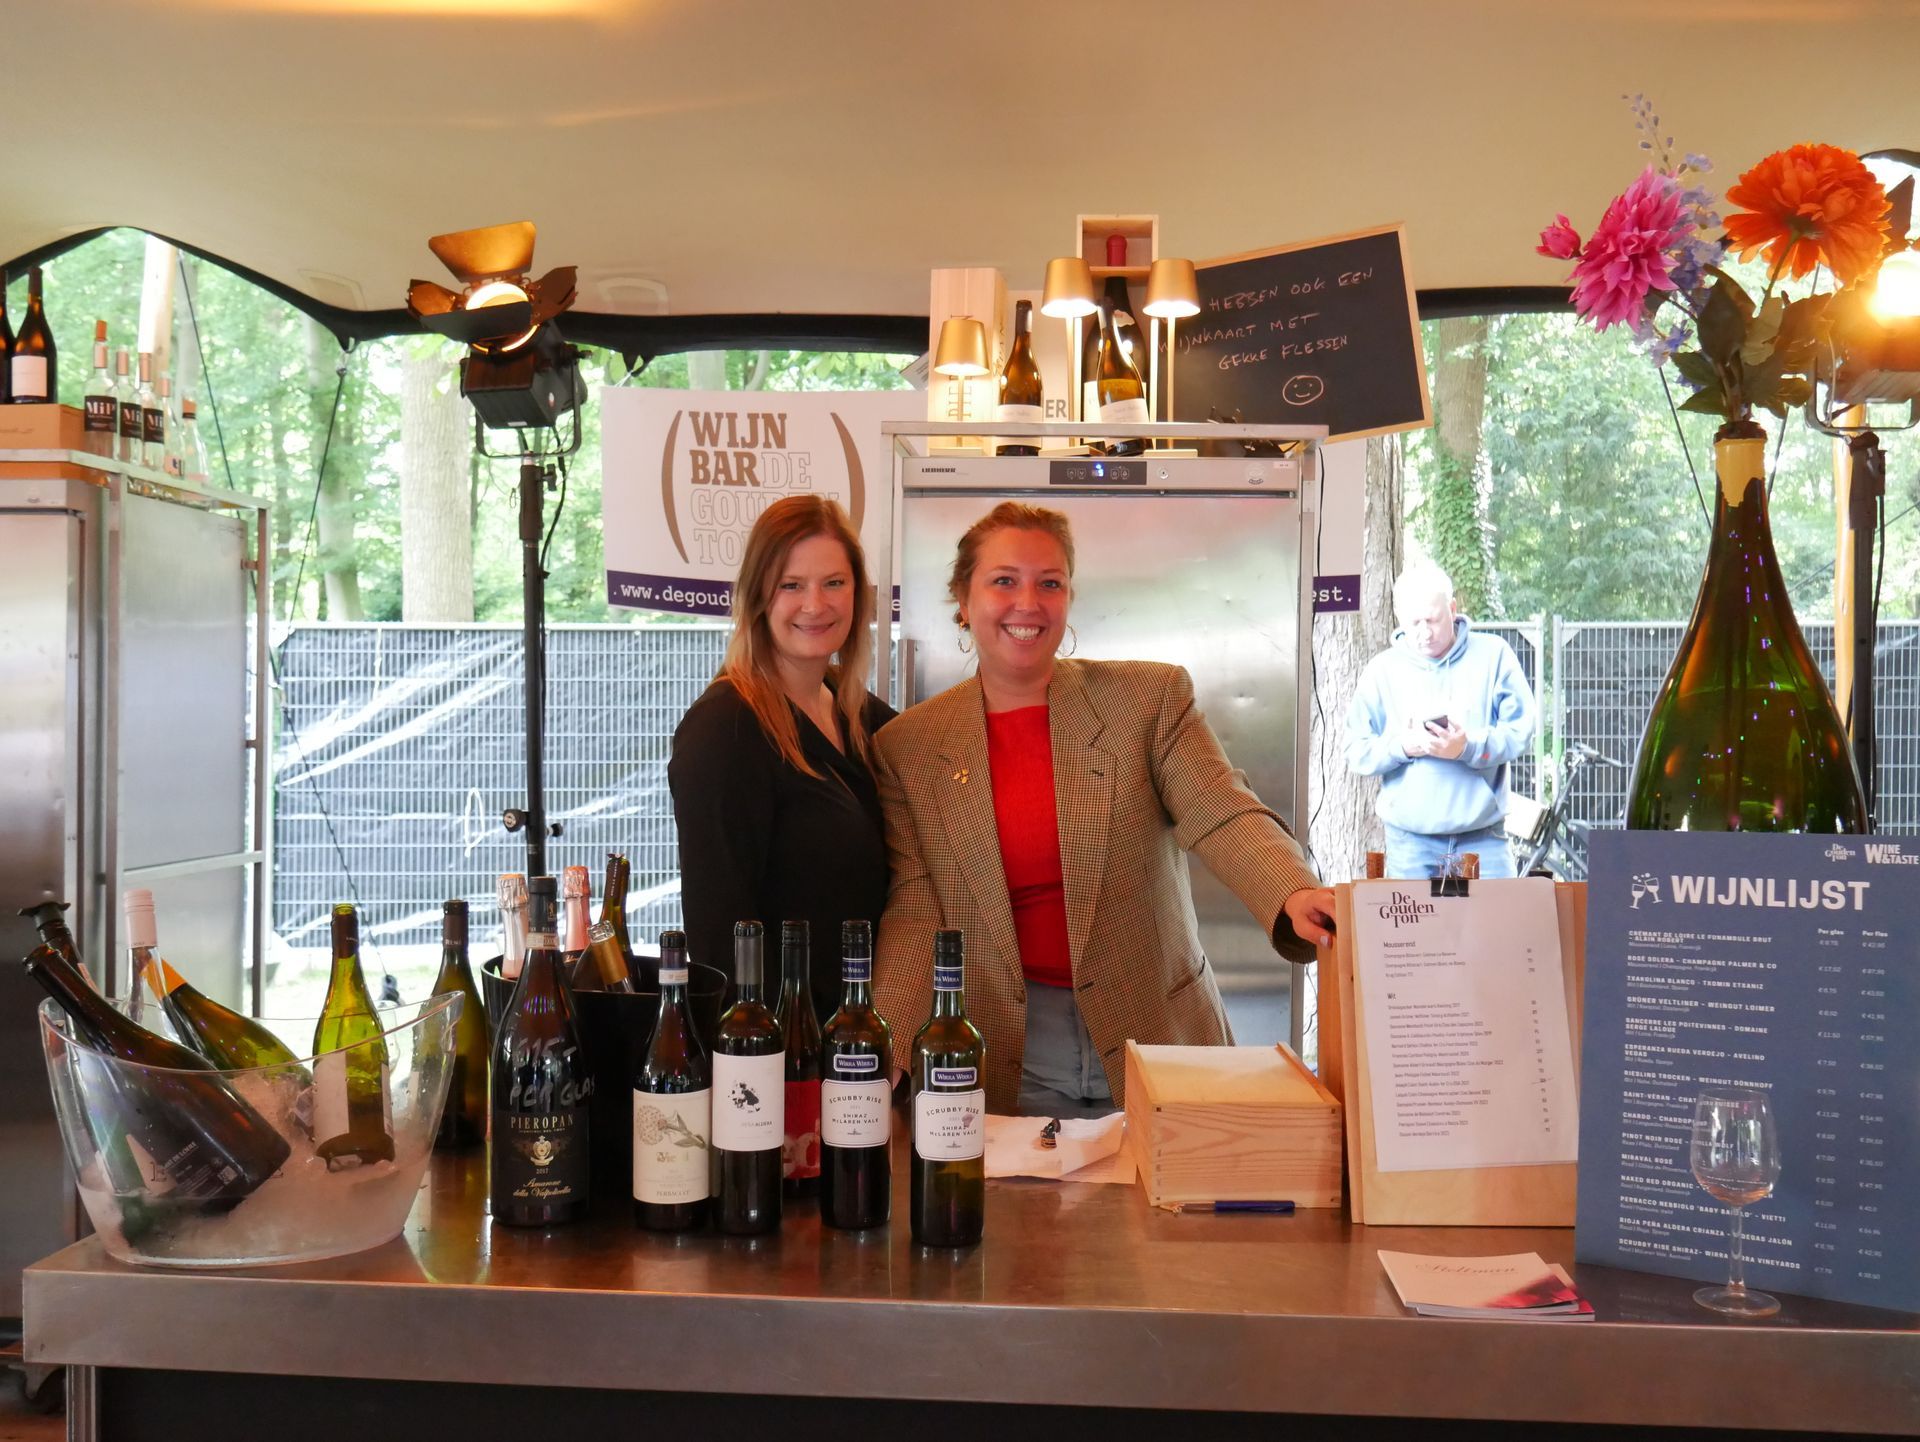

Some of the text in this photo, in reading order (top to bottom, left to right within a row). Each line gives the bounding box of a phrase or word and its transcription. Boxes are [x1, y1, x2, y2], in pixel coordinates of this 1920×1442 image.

[1210, 267, 1373, 310] HEBBEN OOK EEN
[1271, 312, 1320, 330] MET
[1219, 335, 1348, 369] GEKKE FLESSEN
[124, 408, 141, 421] Mi
[147, 414, 163, 428] Mi
[689, 411, 787, 448] WIJN
[690, 450, 811, 488] BAR DE
[693, 528, 746, 566] TO
[1864, 844, 1900, 864] WINE
[1392, 892, 1410, 904] De
[1672, 874, 1870, 911] WIJNLIJST
[1380, 900, 1434, 919] Gouden
[1391, 914, 1419, 928] Ton
[829, 1095, 882, 1104] SCRUBBY RISE
[926, 1107, 962, 1117] SCRUBBY
[511, 1114, 573, 1129] PIEROPAN
